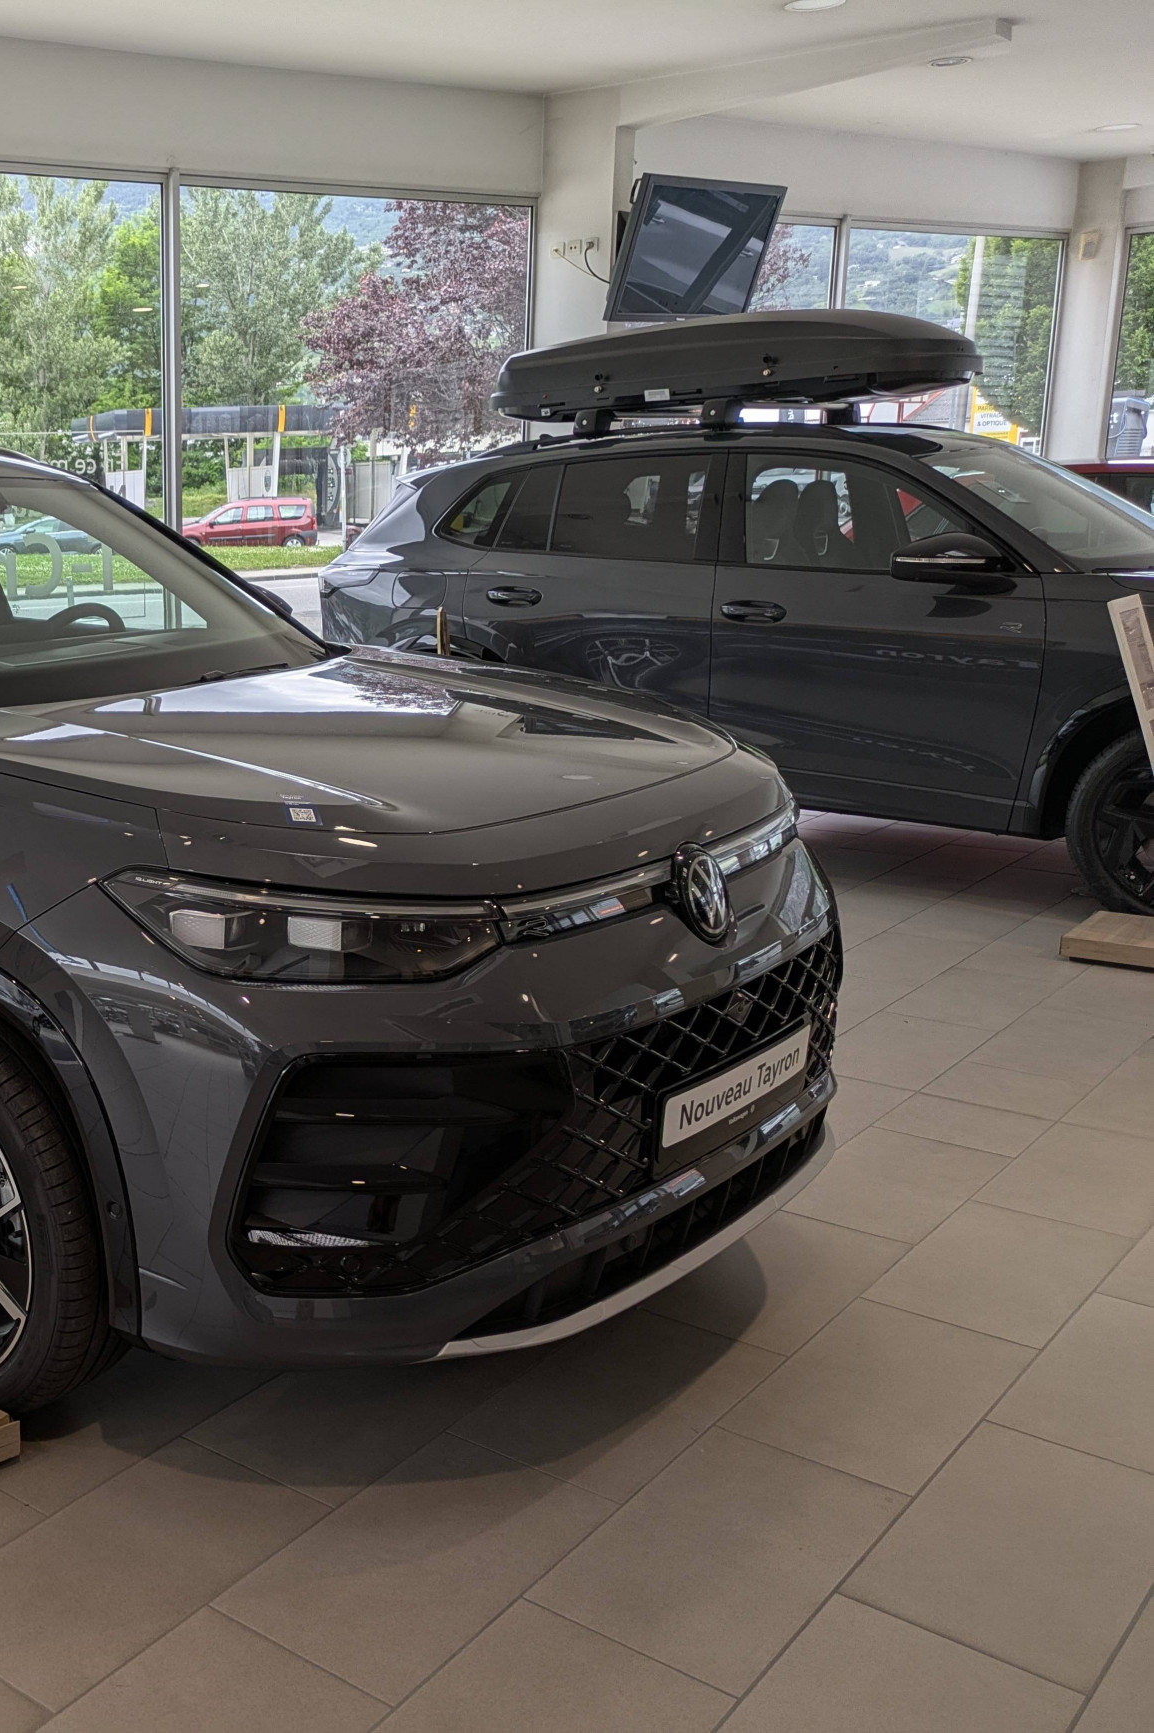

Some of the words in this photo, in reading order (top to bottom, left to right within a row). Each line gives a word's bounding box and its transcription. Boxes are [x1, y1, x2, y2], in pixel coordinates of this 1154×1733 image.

[982, 419, 1007, 427] OPTIQUE
[679, 1076, 751, 1130] Nouveau
[757, 1047, 800, 1088] Tayron
